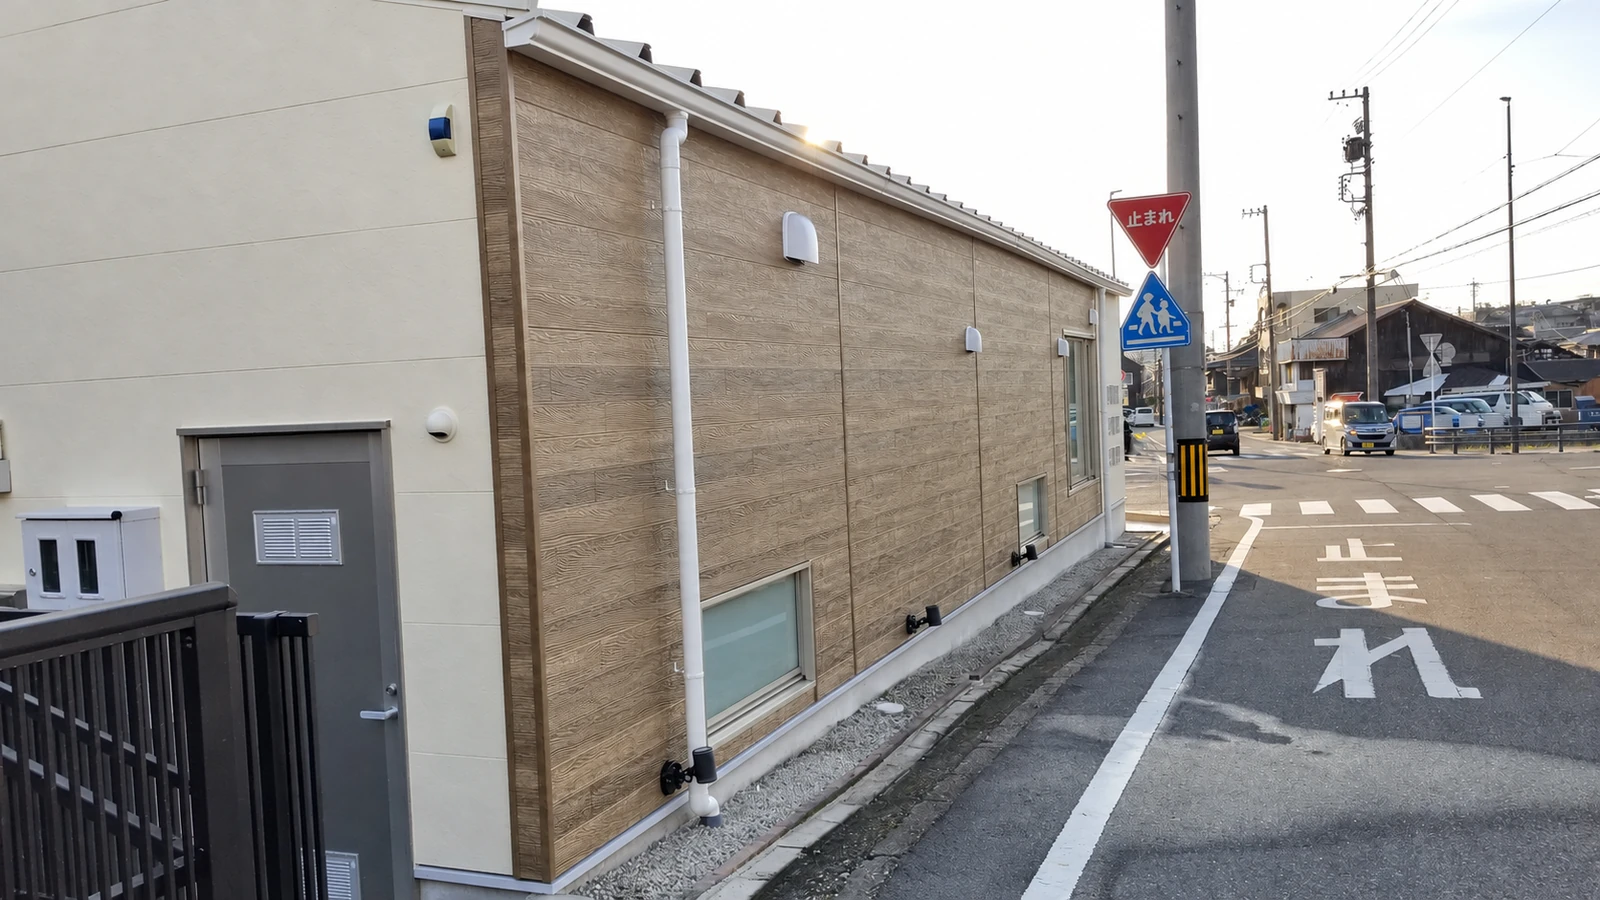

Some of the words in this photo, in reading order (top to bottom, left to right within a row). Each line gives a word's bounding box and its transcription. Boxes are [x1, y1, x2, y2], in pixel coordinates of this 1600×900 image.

[1126, 208, 1175, 228] 止まれ
[1312, 538, 1484, 698] 止まれ
